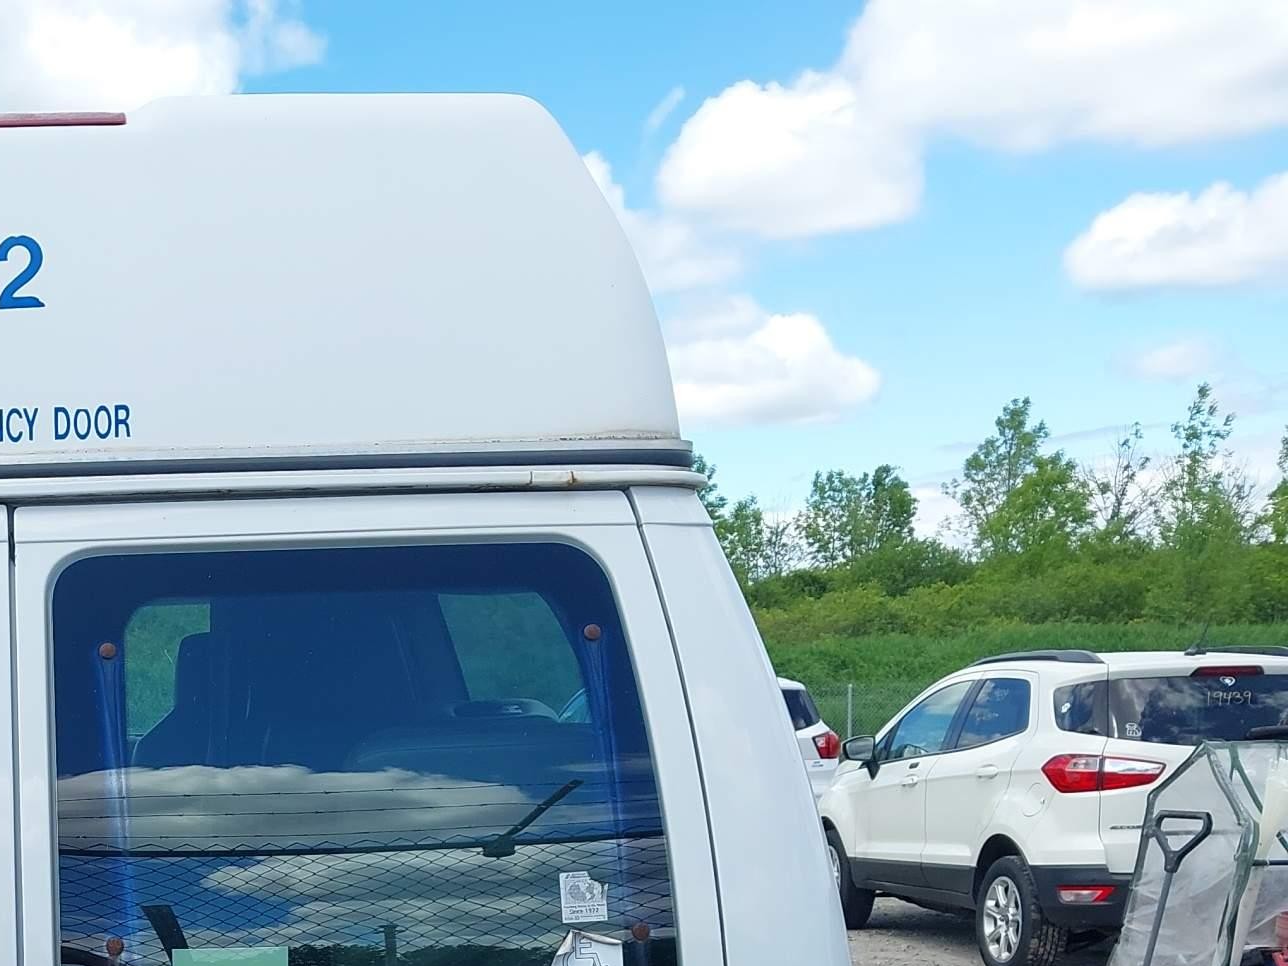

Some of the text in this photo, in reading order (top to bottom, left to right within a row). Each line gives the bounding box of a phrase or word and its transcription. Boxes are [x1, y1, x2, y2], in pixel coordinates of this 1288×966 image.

[54, 404, 131, 440] DOOR
[1206, 690, 1252, 706] 19439
[585, 907, 600, 915] 1972
